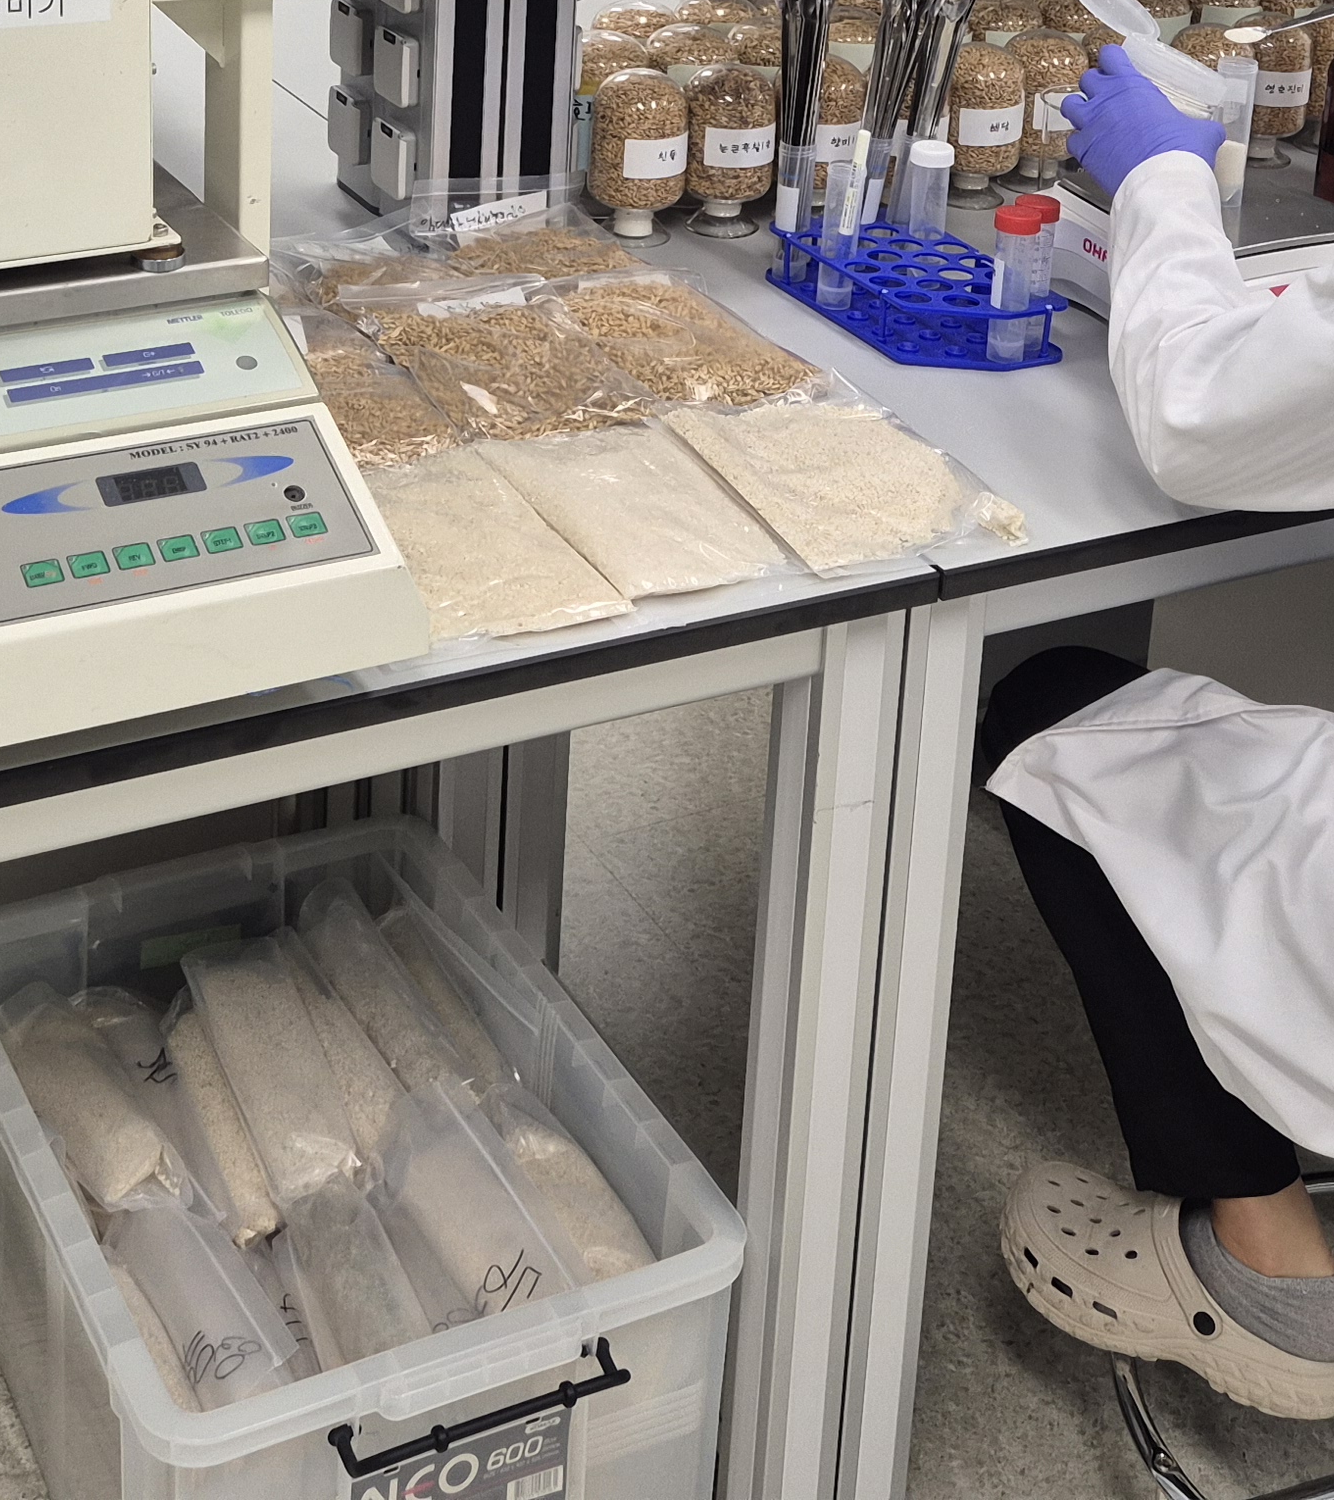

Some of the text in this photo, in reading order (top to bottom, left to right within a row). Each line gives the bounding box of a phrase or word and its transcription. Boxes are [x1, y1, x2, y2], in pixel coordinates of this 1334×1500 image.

[129, 445, 178, 461] MODEL
[186, 439, 202, 451] SY
[203, 437, 219, 449] 94
[220, 436, 229, 445] +
[230, 430, 261, 444] RAT2
[263, 430, 272, 439] +
[273, 425, 299, 438] 2400
[486, 1435, 544, 1471] 600
